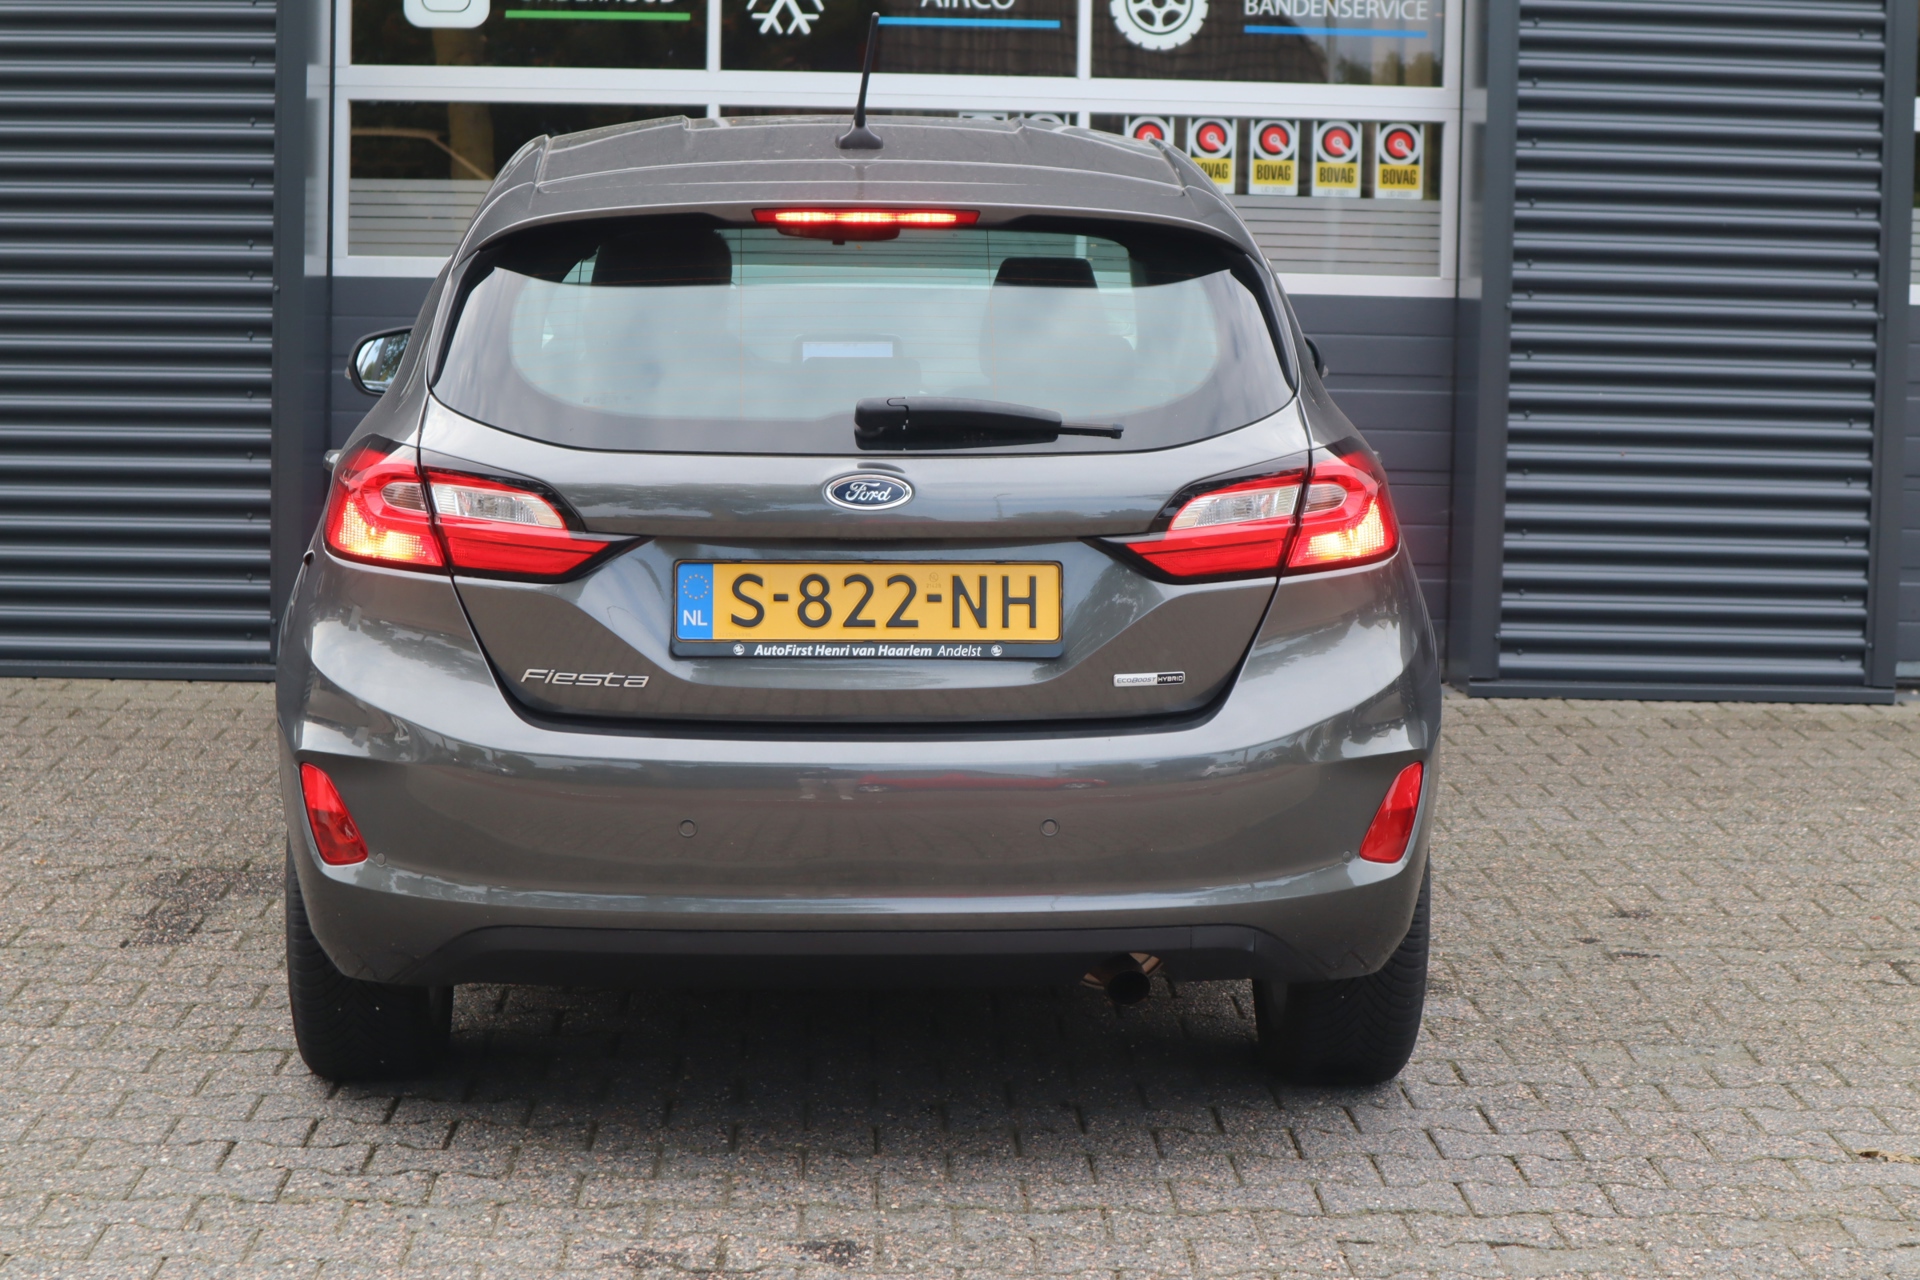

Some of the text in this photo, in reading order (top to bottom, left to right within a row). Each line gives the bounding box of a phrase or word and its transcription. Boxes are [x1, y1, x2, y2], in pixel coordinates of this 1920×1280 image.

[1244, 0, 1428, 20] BANDENSERVICE
[1198, 162, 1229, 179] OVAG
[1256, 164, 1291, 181] BOVAG
[1319, 166, 1354, 183] BOVAG
[1382, 168, 1417, 185] BOVAG
[845, 481, 892, 501] Ford
[730, 573, 1037, 629] S-822-NH
[683, 609, 708, 626] NL
[754, 644, 982, 657] AutoFirst Henri van Haarlem Andelst
[520, 668, 650, 688] Fiesta
